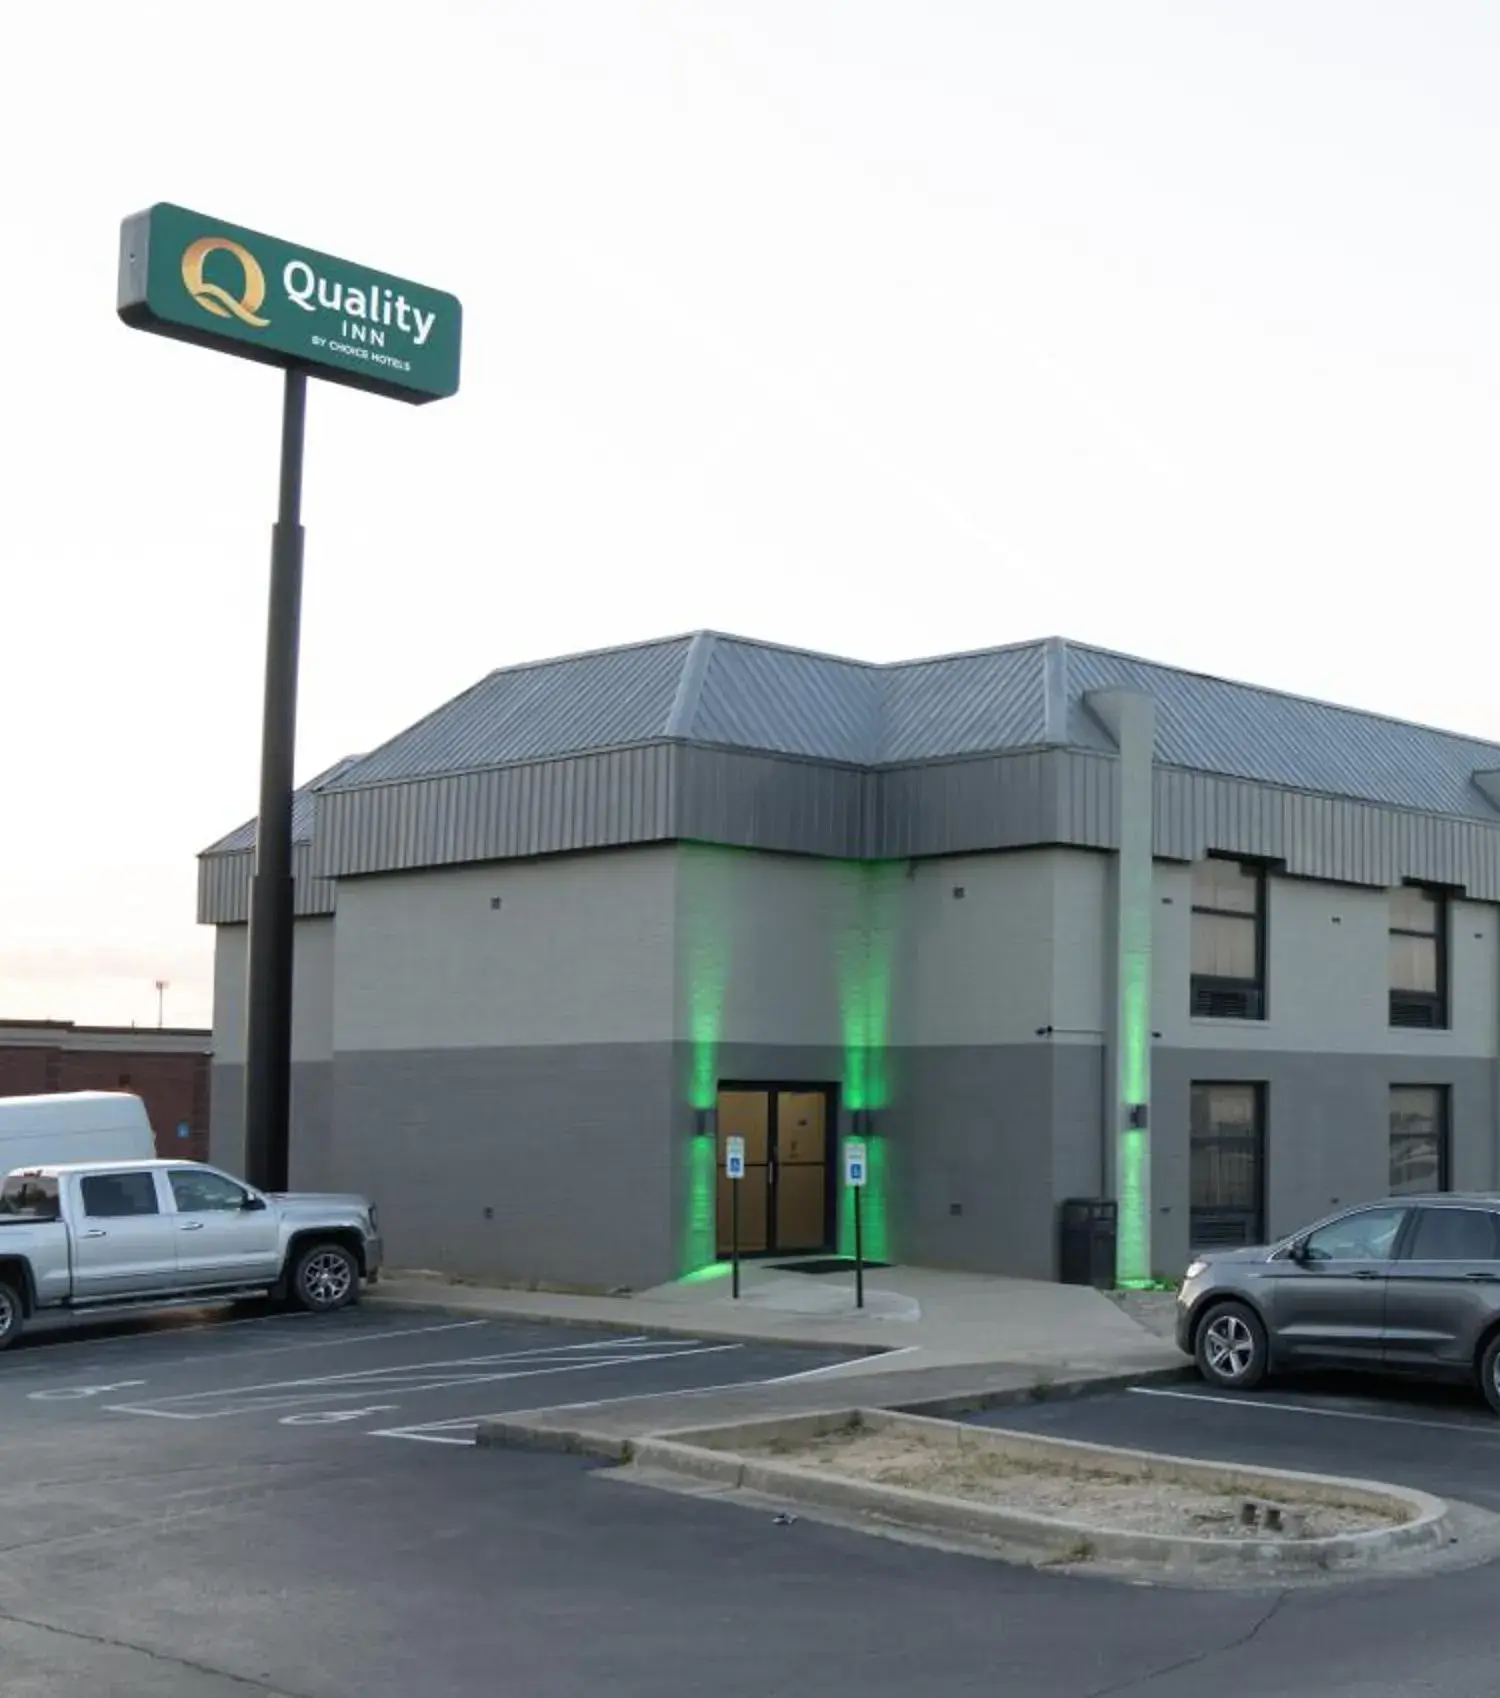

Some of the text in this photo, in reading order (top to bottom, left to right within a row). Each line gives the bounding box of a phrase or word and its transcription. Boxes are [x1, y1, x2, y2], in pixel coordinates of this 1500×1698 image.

[181, 236, 272, 327] Q
[283, 260, 436, 345] Quality
[312, 335, 411, 371] BY CHOICE HOTELS
[342, 319, 385, 347] INN
